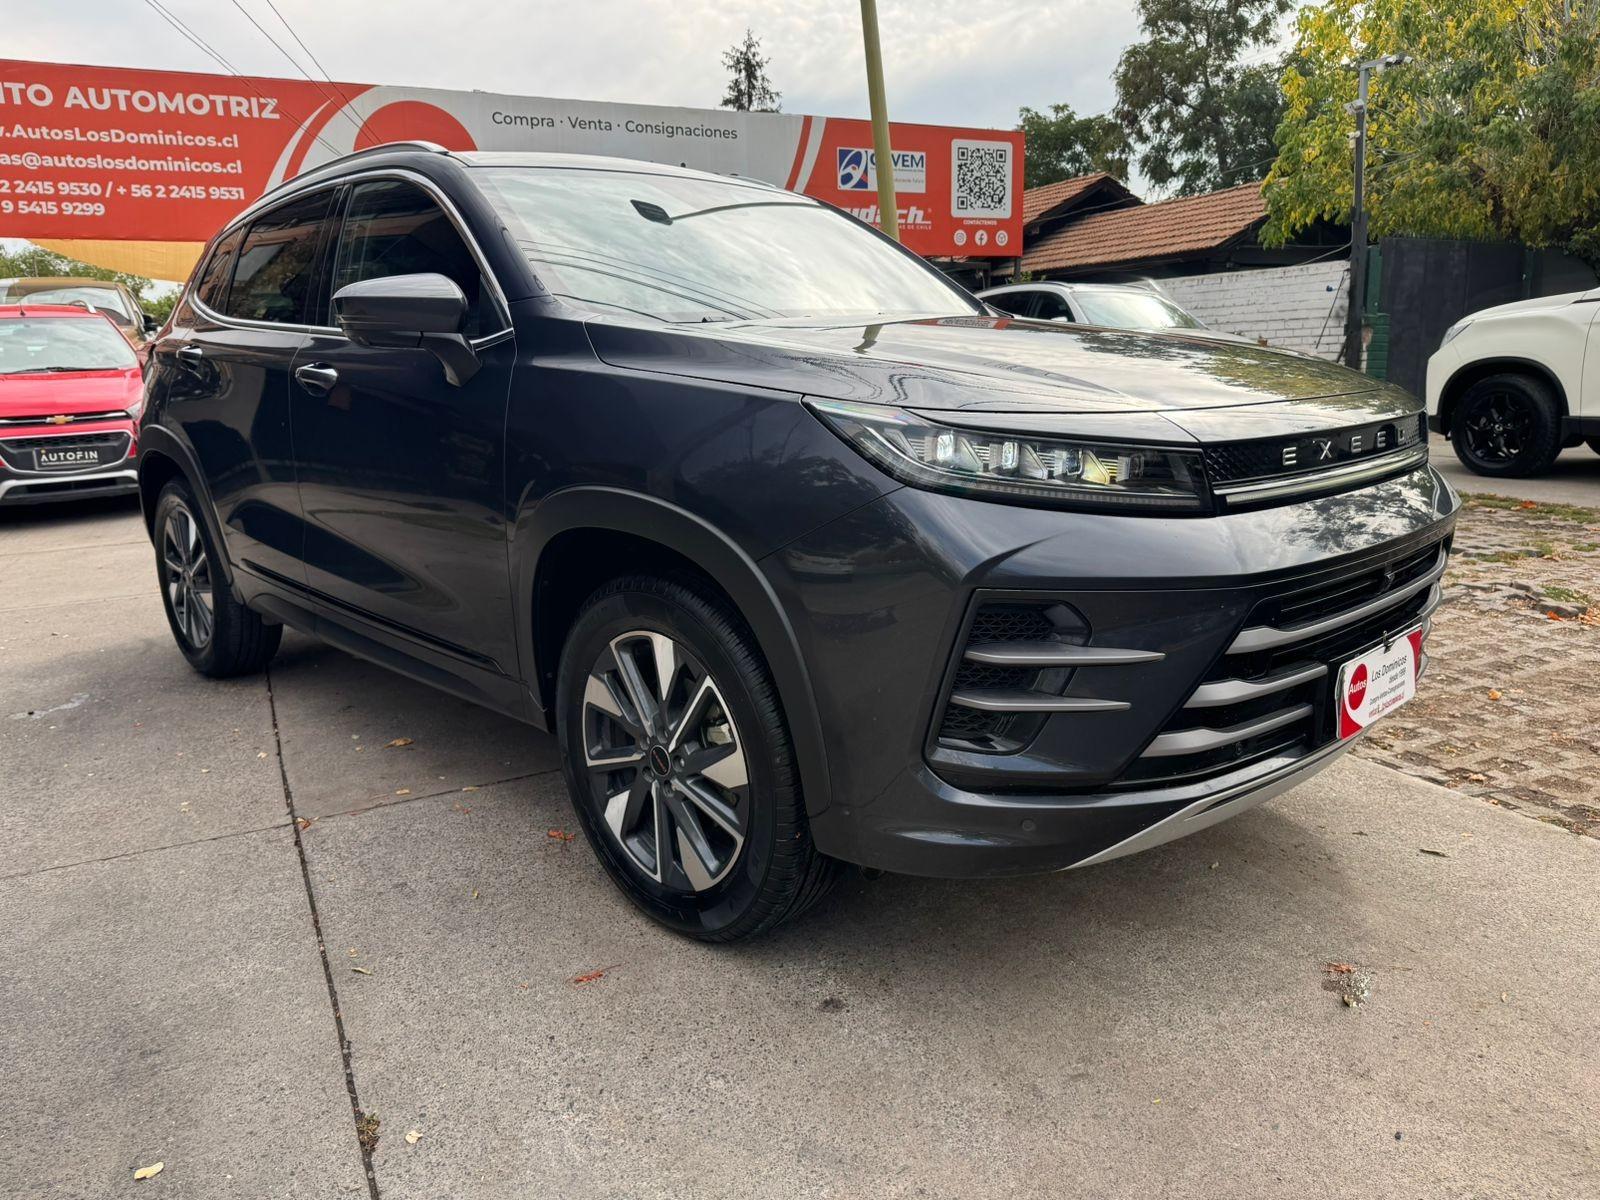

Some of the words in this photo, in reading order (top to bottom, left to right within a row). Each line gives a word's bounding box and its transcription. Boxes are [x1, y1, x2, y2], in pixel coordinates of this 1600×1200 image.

[0, 82, 54, 107] TO
[64, 86, 280, 119] AUTOMOTRIZ
[492, 111, 554, 129] Compra
[568, 116, 612, 131] Venta
[625, 120, 738, 139] Consignaciones
[870, 153, 924, 168] VEM
[0, 180, 11, 193] 2
[13, 180, 55, 195] 2415
[58, 181, 102, 196] 9530
[105, 181, 113, 198] /
[116, 185, 127, 195] +
[131, 184, 152, 198] 56
[155, 184, 167, 198] 2
[169, 185, 206, 199] 2415
[208, 187, 245, 200] 9531
[1, 200, 14, 214] 9
[18, 201, 58, 215] 5415
[61, 201, 105, 216] 9299
[41, 449, 98, 462] AUTOFIN
[1371, 668, 1381, 682] Los
[1348, 680, 1367, 694] Autos
